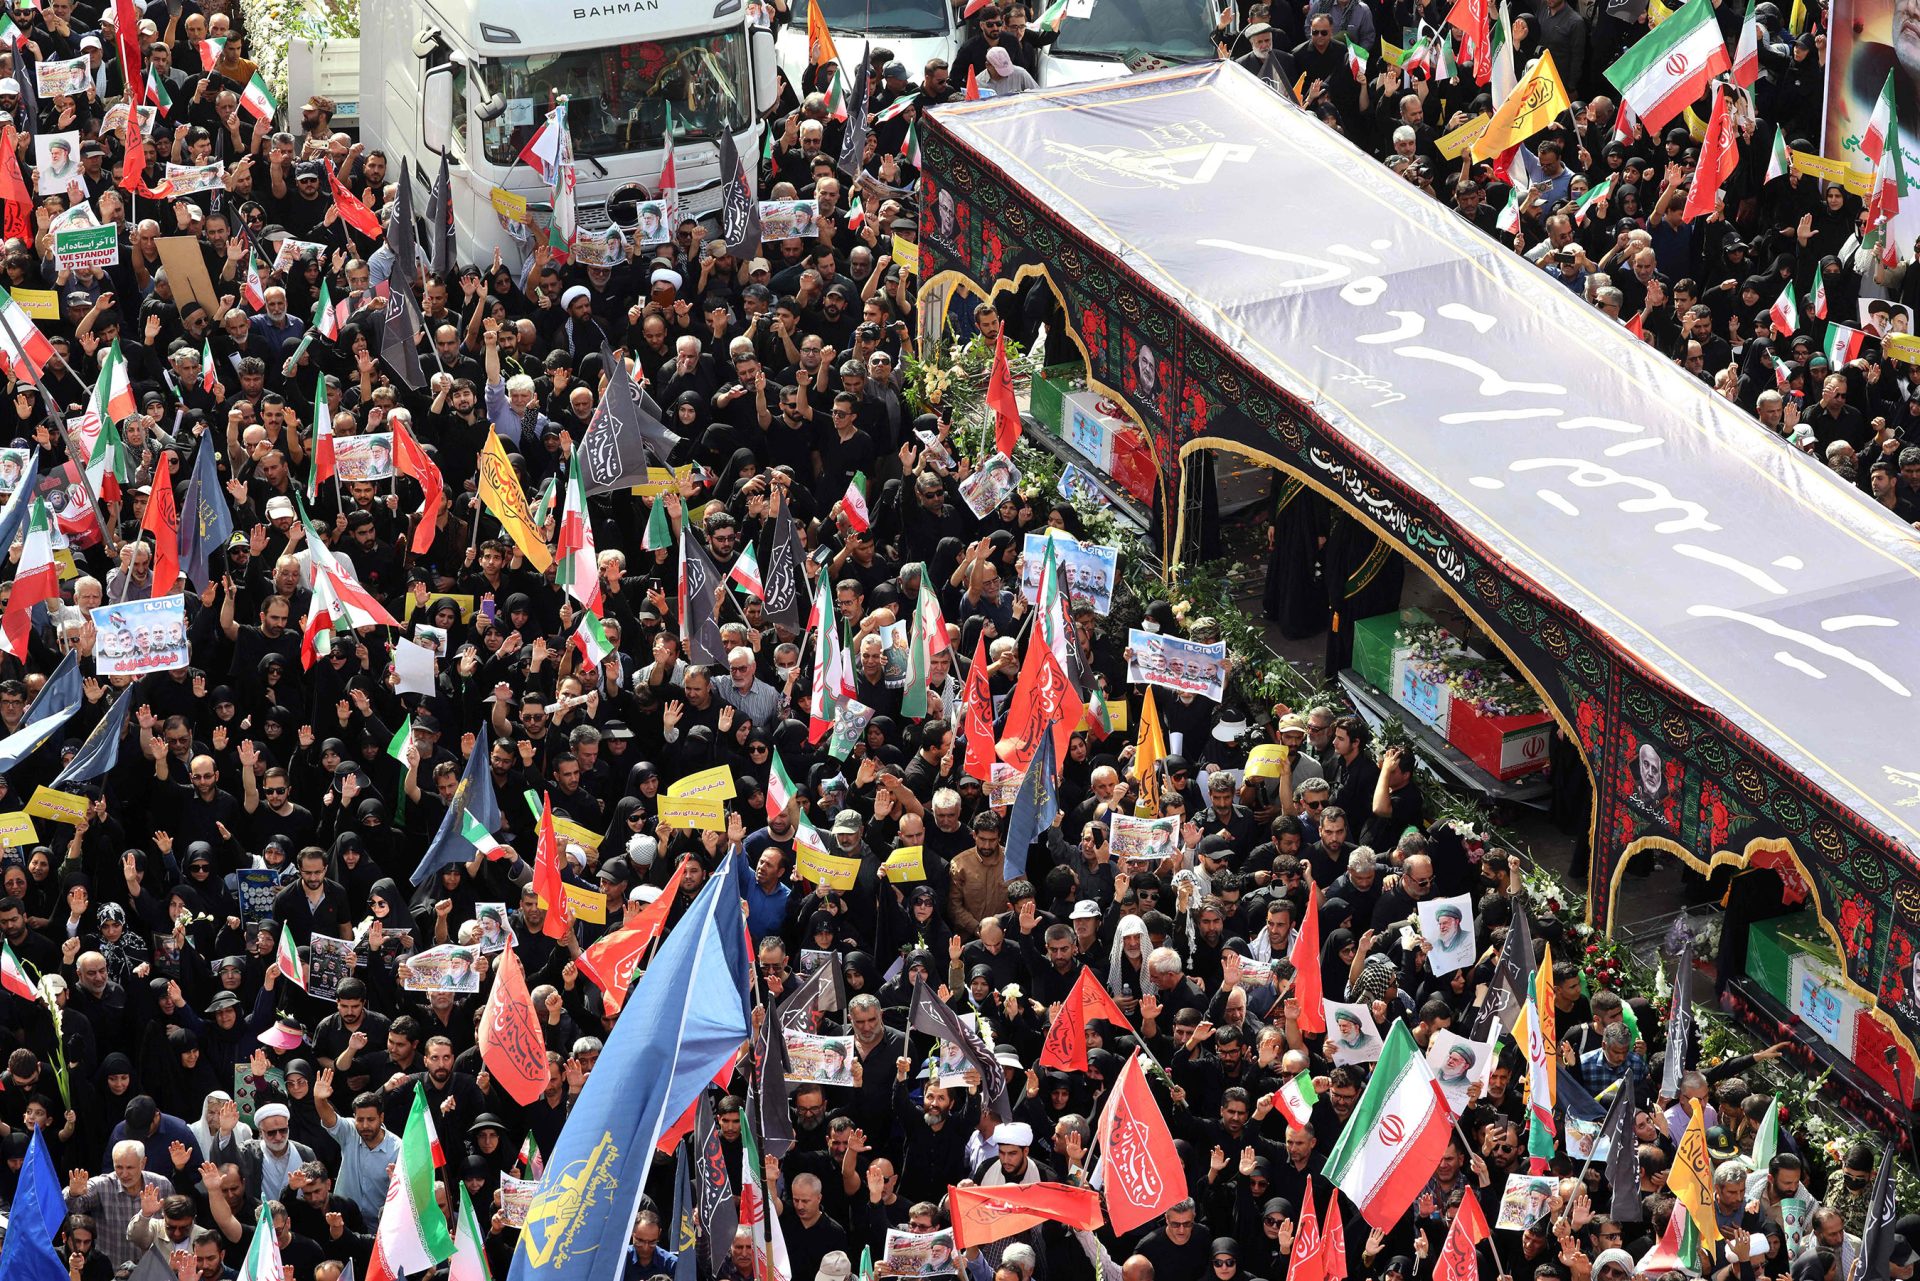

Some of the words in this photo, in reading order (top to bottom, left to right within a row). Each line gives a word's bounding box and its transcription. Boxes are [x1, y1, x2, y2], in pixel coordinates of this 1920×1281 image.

[573, 0, 660, 19] BAHMAN
[59, 254, 74, 262] WE
[93, 257, 111, 266] END
[1310, 447, 1346, 486] است
[1346, 469, 1394, 520] پیروز
[1406, 523, 1450, 550] حسین
[1436, 546, 1466, 582] ایران
